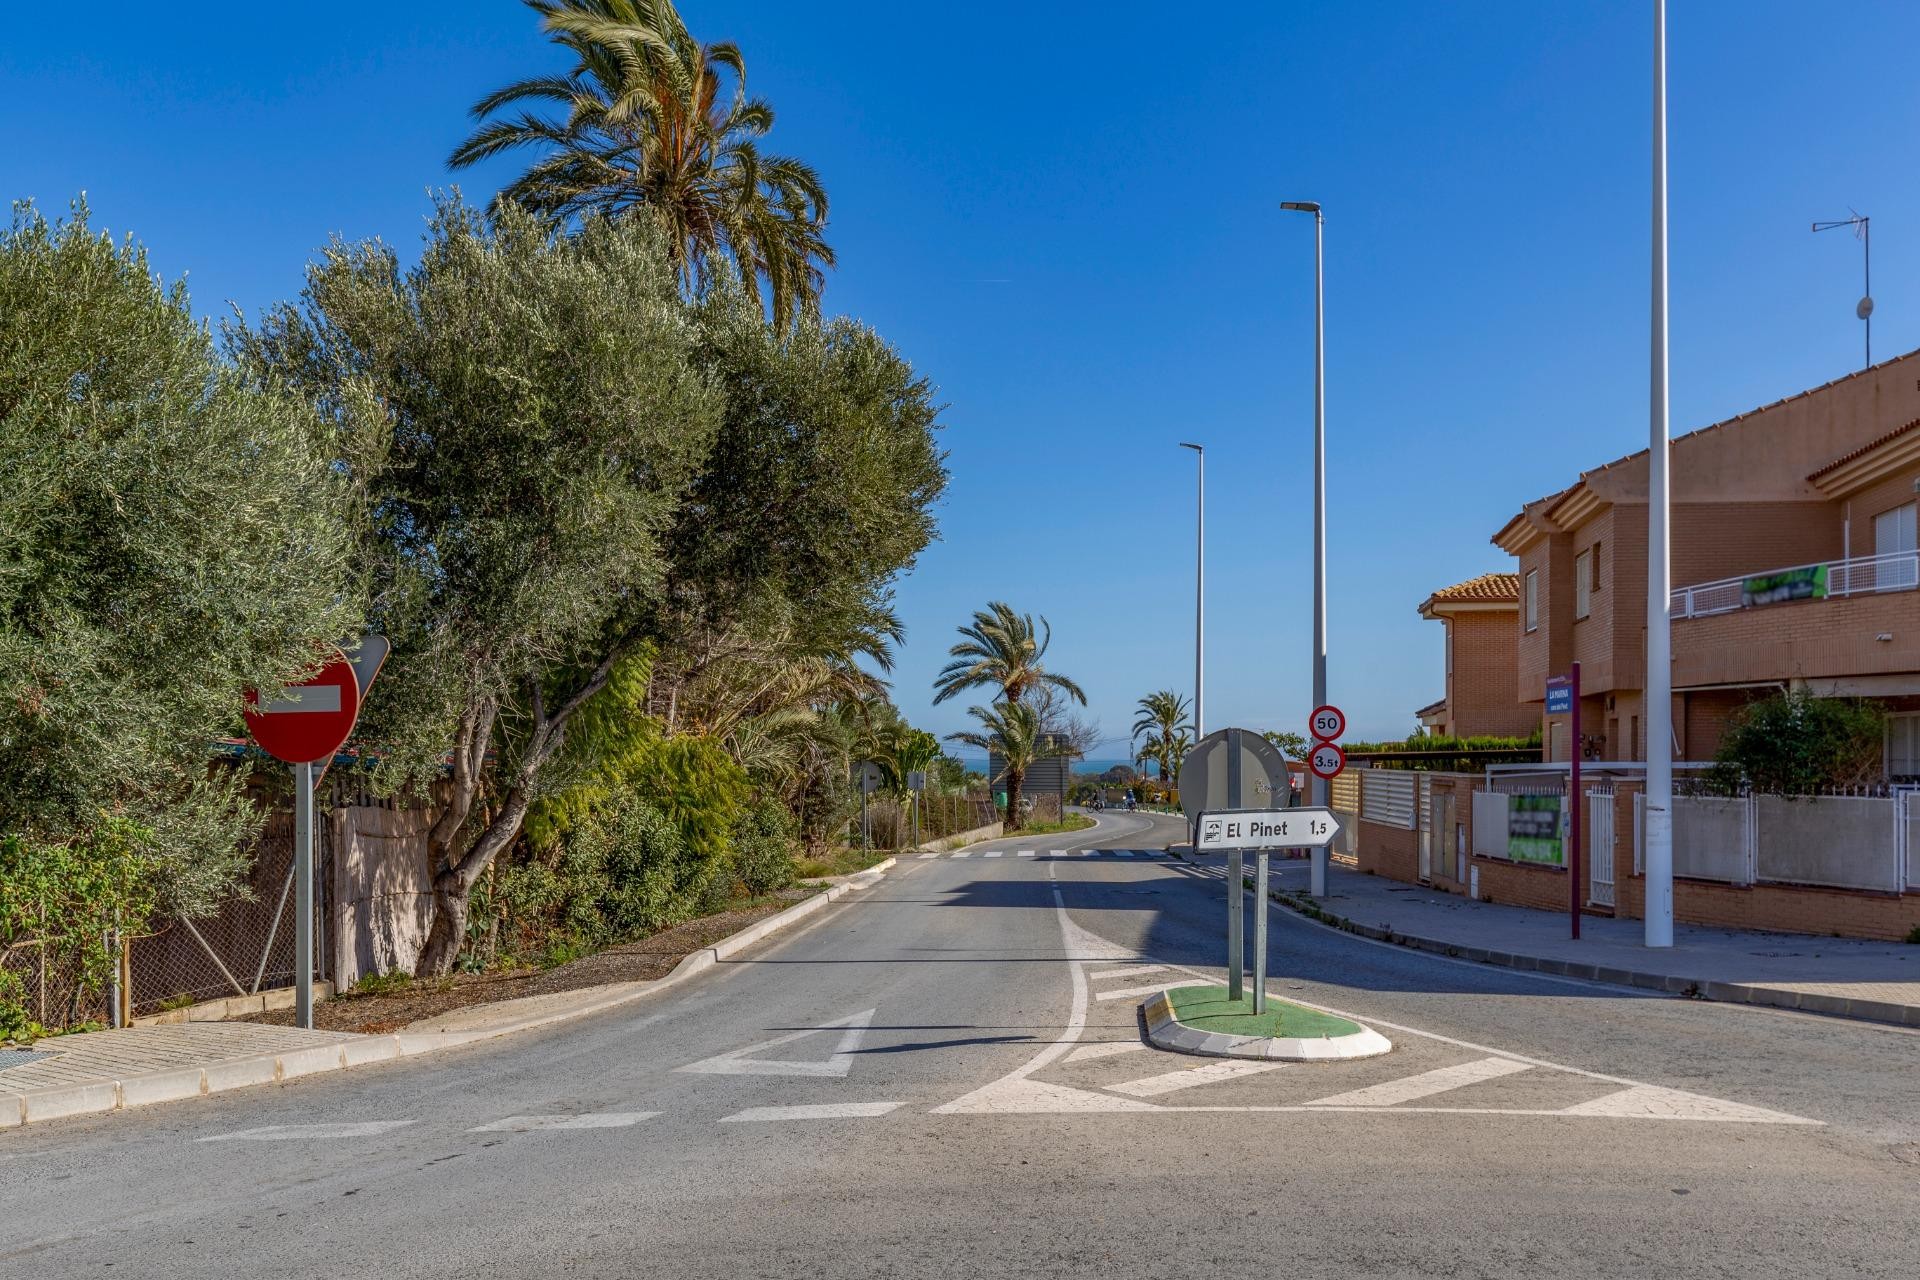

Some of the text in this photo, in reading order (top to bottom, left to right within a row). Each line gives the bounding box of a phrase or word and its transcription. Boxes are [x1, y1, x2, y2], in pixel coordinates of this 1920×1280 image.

[1317, 717, 1337, 730] 50
[1226, 819, 1327, 838] El Pinet 1,5
